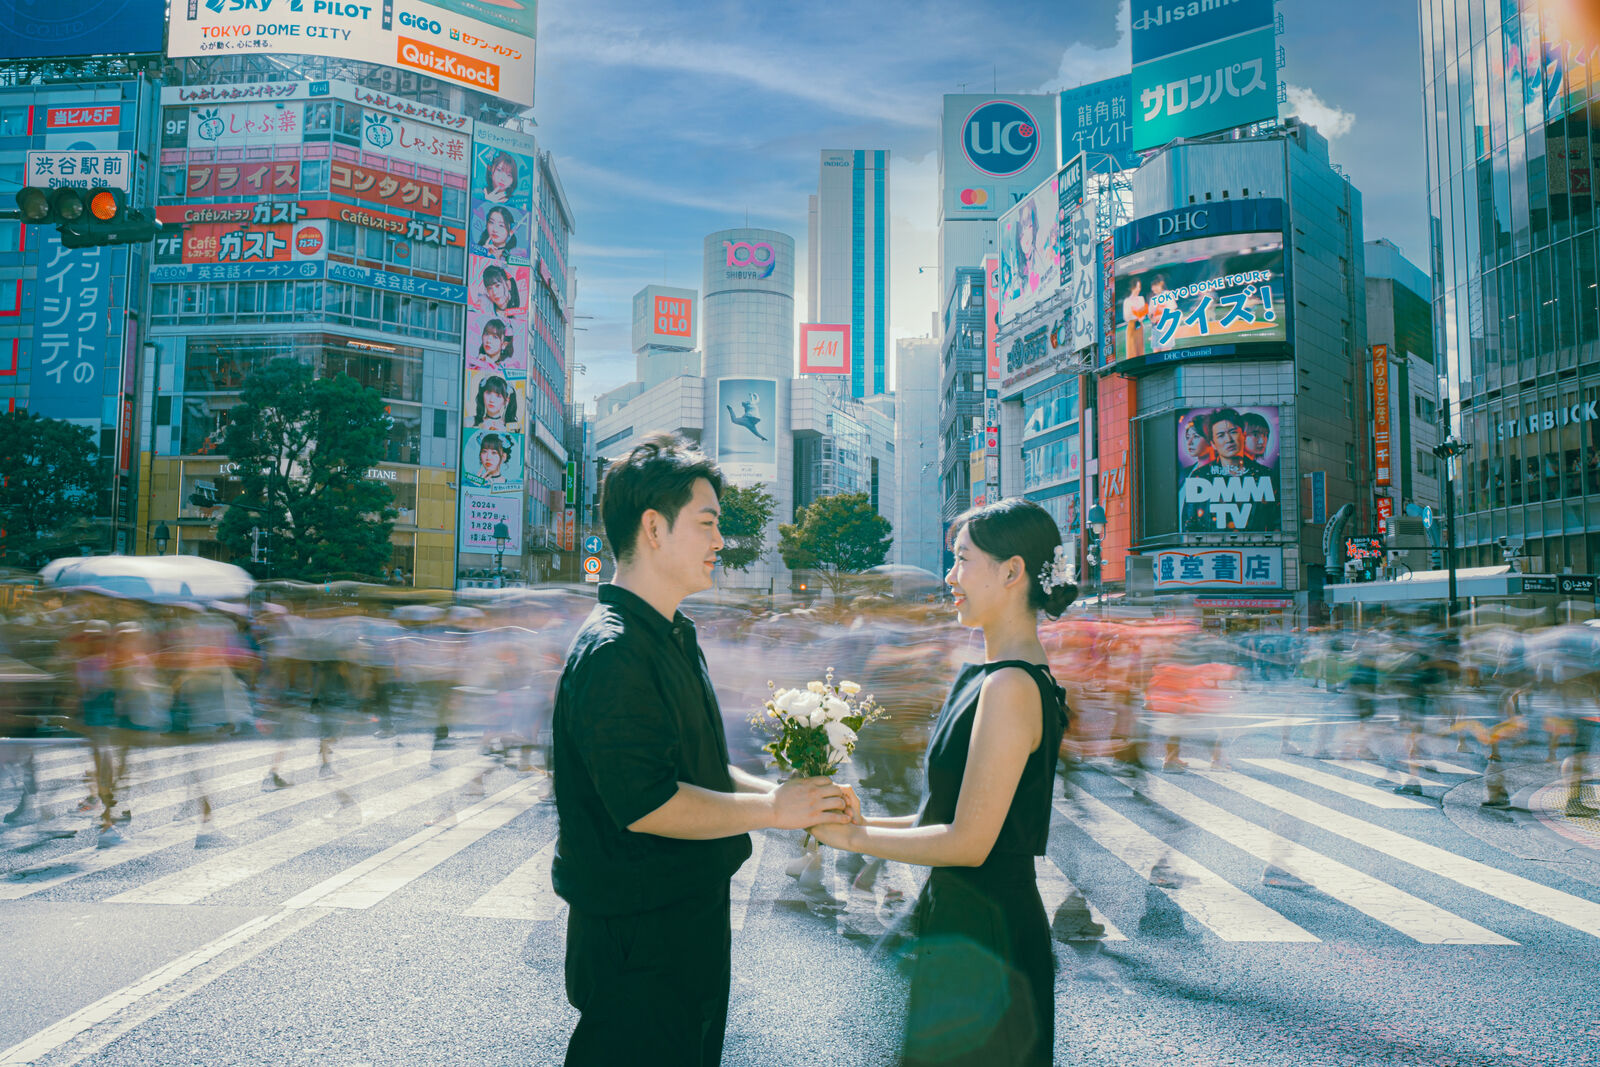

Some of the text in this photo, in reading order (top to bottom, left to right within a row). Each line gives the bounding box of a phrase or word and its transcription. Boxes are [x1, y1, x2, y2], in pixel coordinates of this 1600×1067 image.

[313, 0, 372, 20] PILOT
[200, 24, 352, 41] TOKYO DOME CITY
[399, 12, 442, 35] GiGO
[402, 44, 495, 87] QuizKnock
[179, 83, 298, 101] しゃぶしゃぶバイキング
[1140, 58, 1267, 122] サロンパス
[54, 109, 114, 125] 当ビル5F
[354, 87, 467, 129] しゃぶしゃぶバイキング
[1078, 96, 1127, 128] 龍角散
[165, 119, 187, 135] 9F
[229, 110, 297, 134] しゃぶ葉
[399, 126, 465, 162] しゃぶ葉
[1072, 121, 1133, 151] ダイレクト
[36, 156, 122, 175] 渋谷駅前
[48, 177, 111, 188] Shibuya Sta.
[189, 164, 299, 191] プライス
[331, 164, 441, 208] コンタクト
[253, 201, 308, 225] ガスト
[1158, 210, 1209, 236] DHC
[188, 236, 217, 250] Café
[298, 239, 321, 248] ガスト
[406, 220, 457, 247] ガスト
[157, 237, 182, 256] 7F
[219, 231, 287, 261] ガスト
[302, 265, 316, 275] 6F
[723, 241, 776, 279] 109
[157, 268, 187, 278] AEON
[334, 268, 365, 280] AEON
[725, 271, 757, 280] SHIBUYA
[1074, 209, 1093, 340] もんじゃ
[1152, 270, 1271, 306] TOKYO DOME TOURで
[658, 301, 686, 318] UNI
[658, 317, 688, 333] QLO
[1163, 347, 1212, 361] DHC Channel
[1376, 431, 1390, 480] 三千里
[1185, 476, 1276, 503] DMM
[471, 501, 496, 509] 2024年
[1209, 503, 1253, 529] TV
[471, 522, 494, 530] 1月28
[1154, 554, 1272, 581] 盛堂書店
